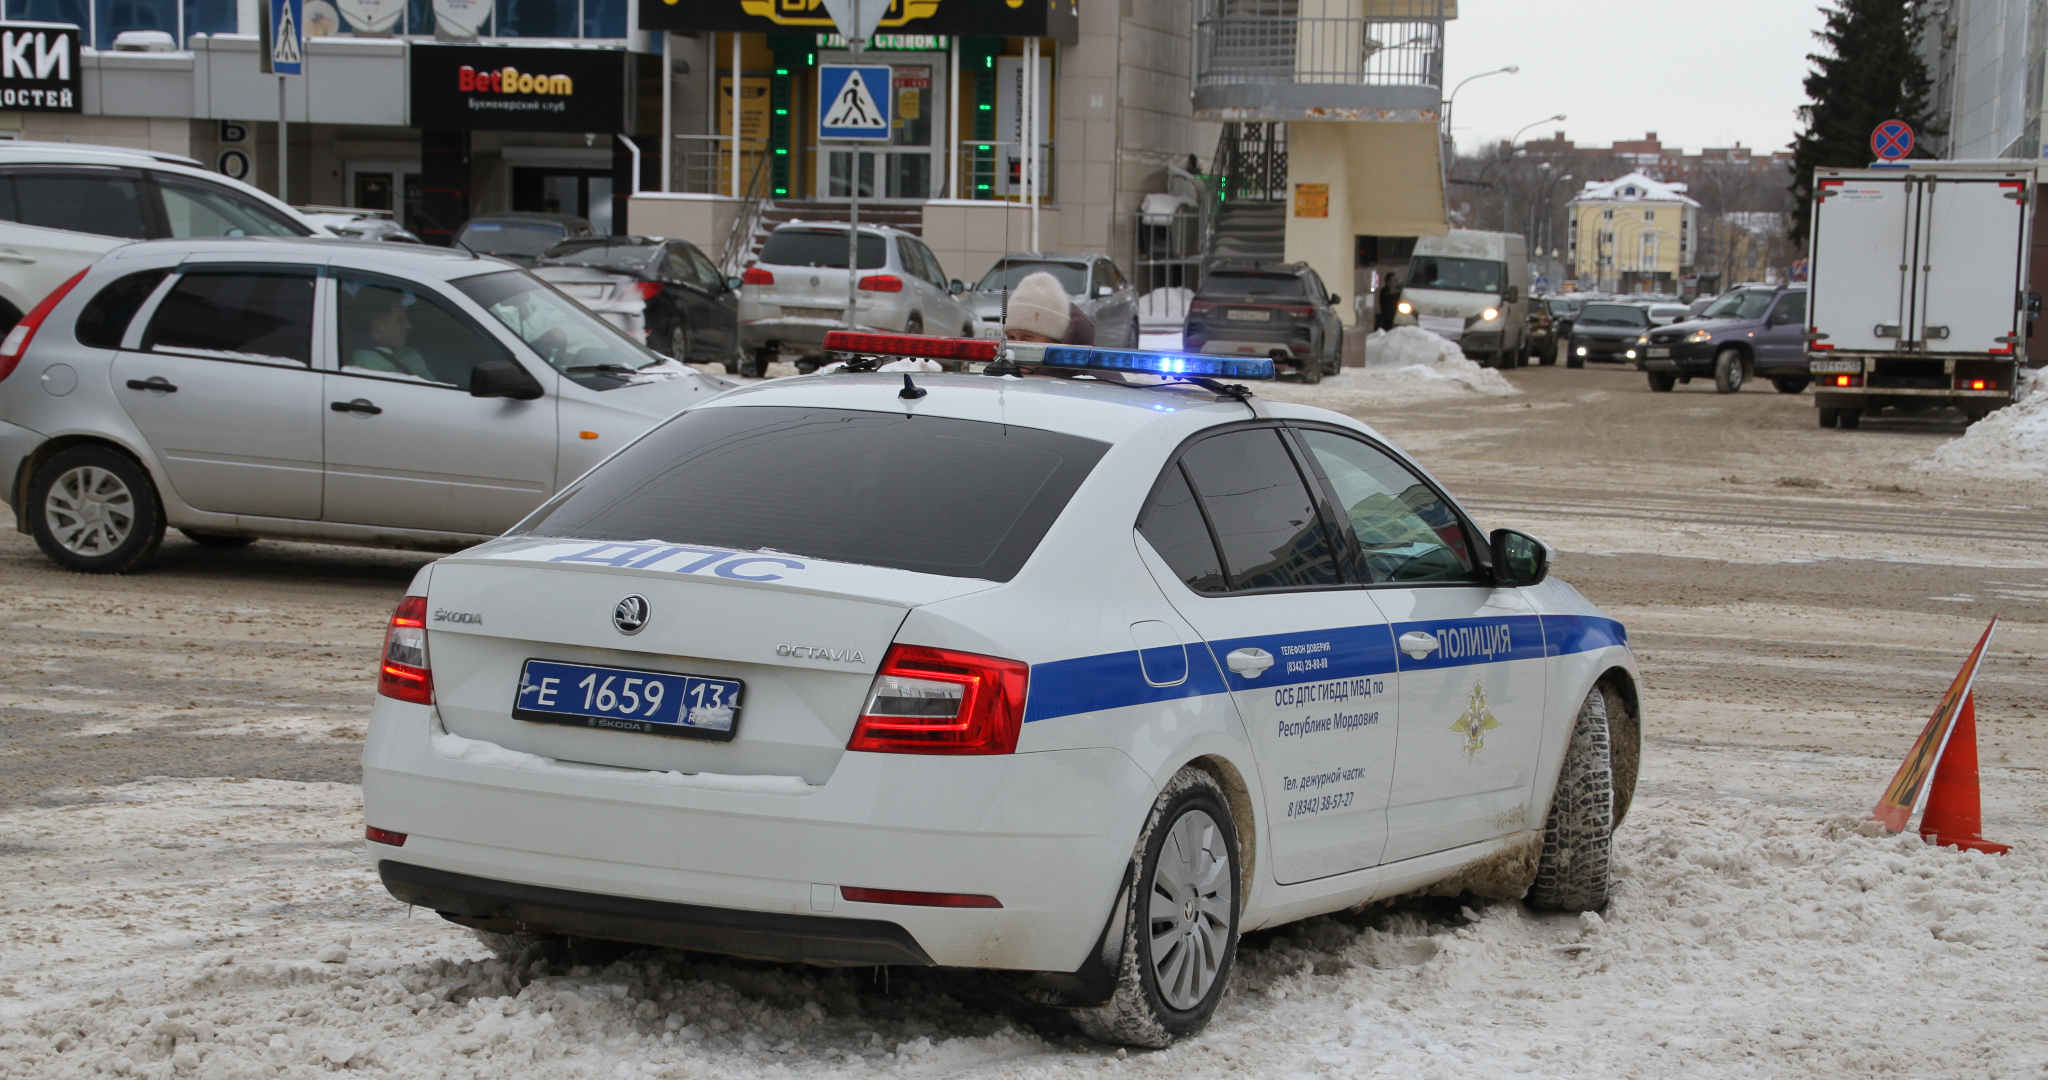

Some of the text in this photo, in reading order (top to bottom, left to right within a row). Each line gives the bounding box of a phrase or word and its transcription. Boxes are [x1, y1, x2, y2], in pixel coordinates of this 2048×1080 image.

[2, 29, 71, 81] КИ
[459, 65, 573, 95] BetBoom
[0, 88, 73, 108] ОСТЕЙ
[547, 543, 806, 582] ДПС
[433, 607, 483, 625] ŠKODA
[776, 643, 865, 664] OCTAVIA
[1280, 641, 1331, 655] ТЕЛЕФОН ДОВЕРИЯ
[1436, 624, 1512, 660] ПОЛИЦИЯ
[537, 672, 725, 716] Е 1659 13
[1274, 678, 1384, 708] ОСБ ДПС ГИБДД МВД по
[598, 718, 641, 730] ŠKODA
[1278, 711, 1379, 739] Республике Мордовия
[1283, 766, 1366, 792] Тел. дежурной части:
[1287, 791, 1355, 819] 8 (8342) 38-57-27
